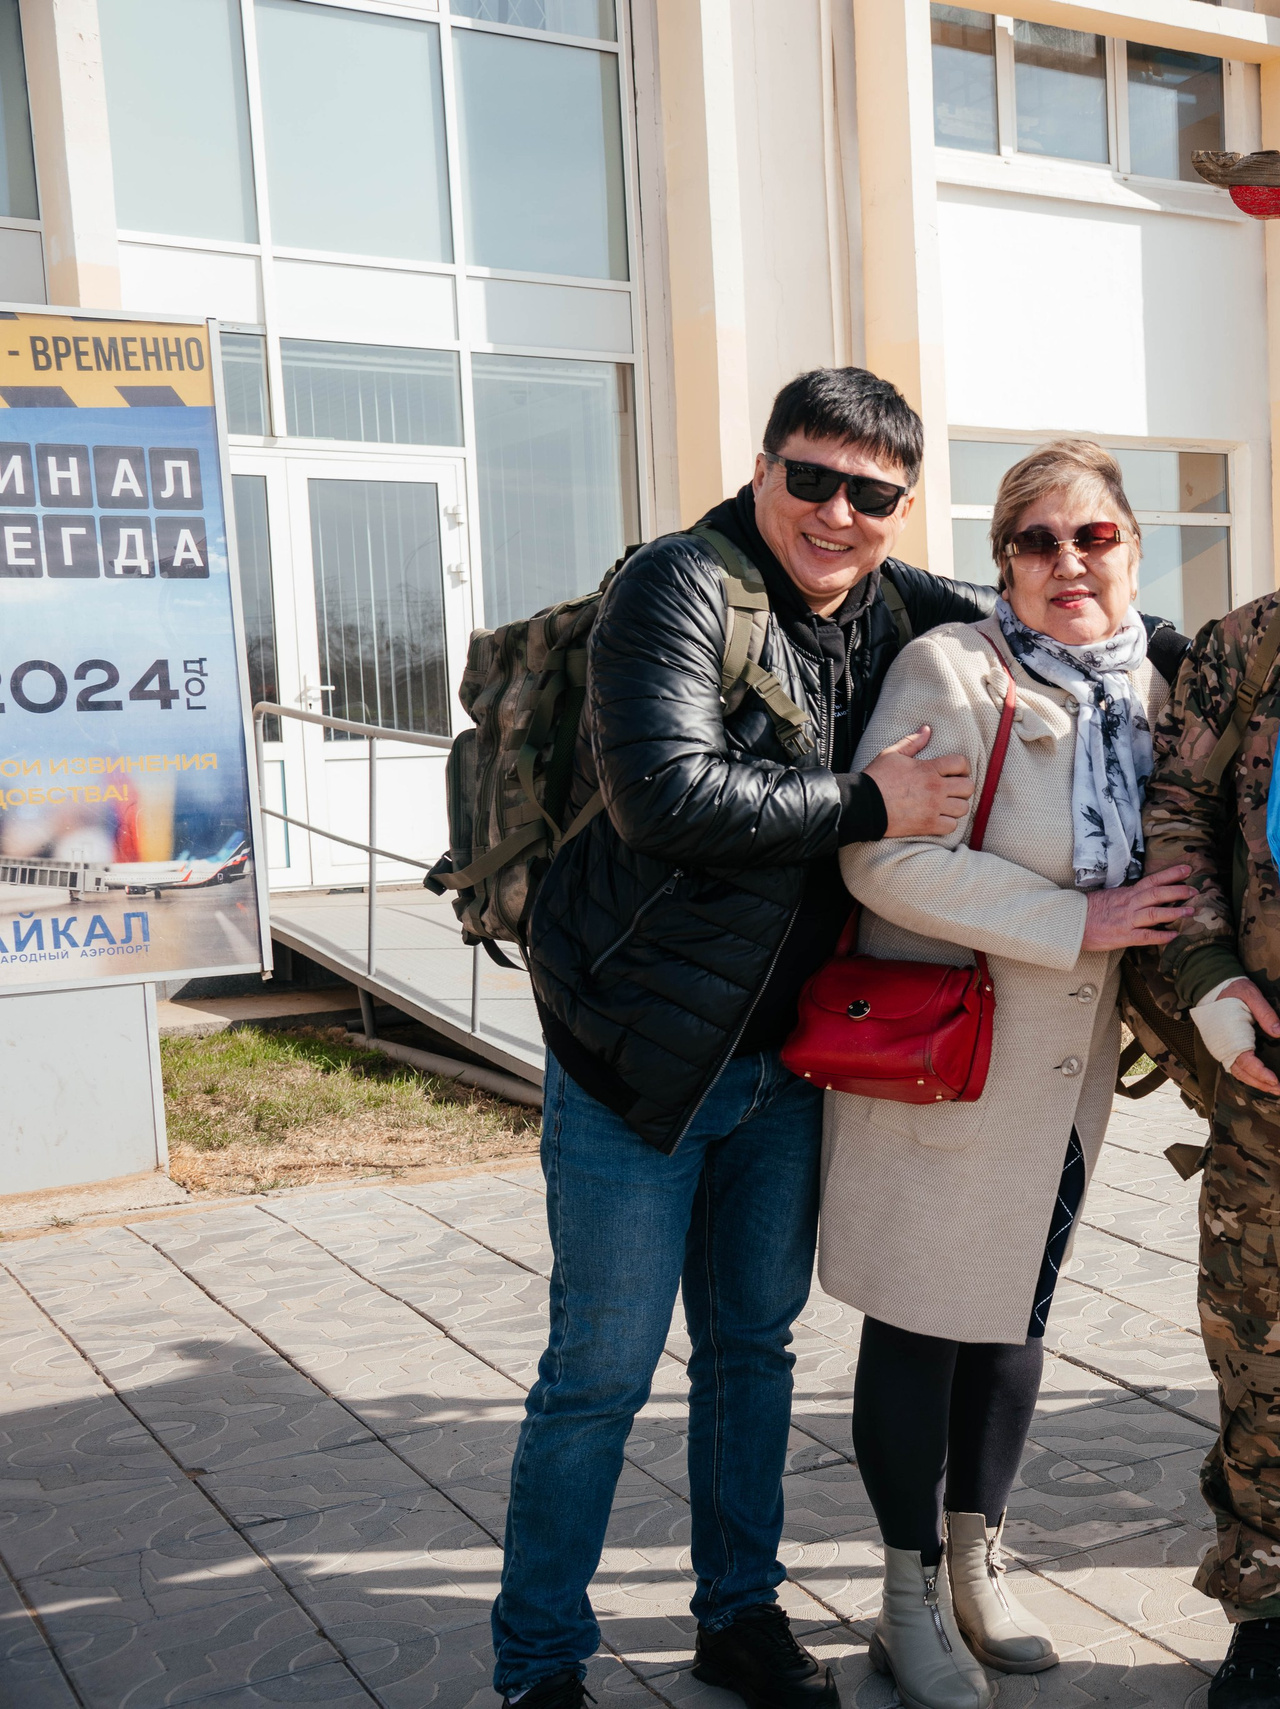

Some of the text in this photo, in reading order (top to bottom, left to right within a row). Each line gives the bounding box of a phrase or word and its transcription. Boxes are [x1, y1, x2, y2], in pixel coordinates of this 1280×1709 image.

[29, 335, 205, 371] ВРЕМЕННО
[0, 455, 192, 499] ИНАЛ
[3, 526, 205, 575] ЕГДА
[0, 659, 180, 714] 024
[183, 657, 208, 710] ГОД
[50, 753, 218, 775] ИЗВИНЕНИЯ
[0, 911, 150, 953] ЙКАЛ
[0, 944, 150, 964] АРОДНЫЙ АЭРОПОРТ
